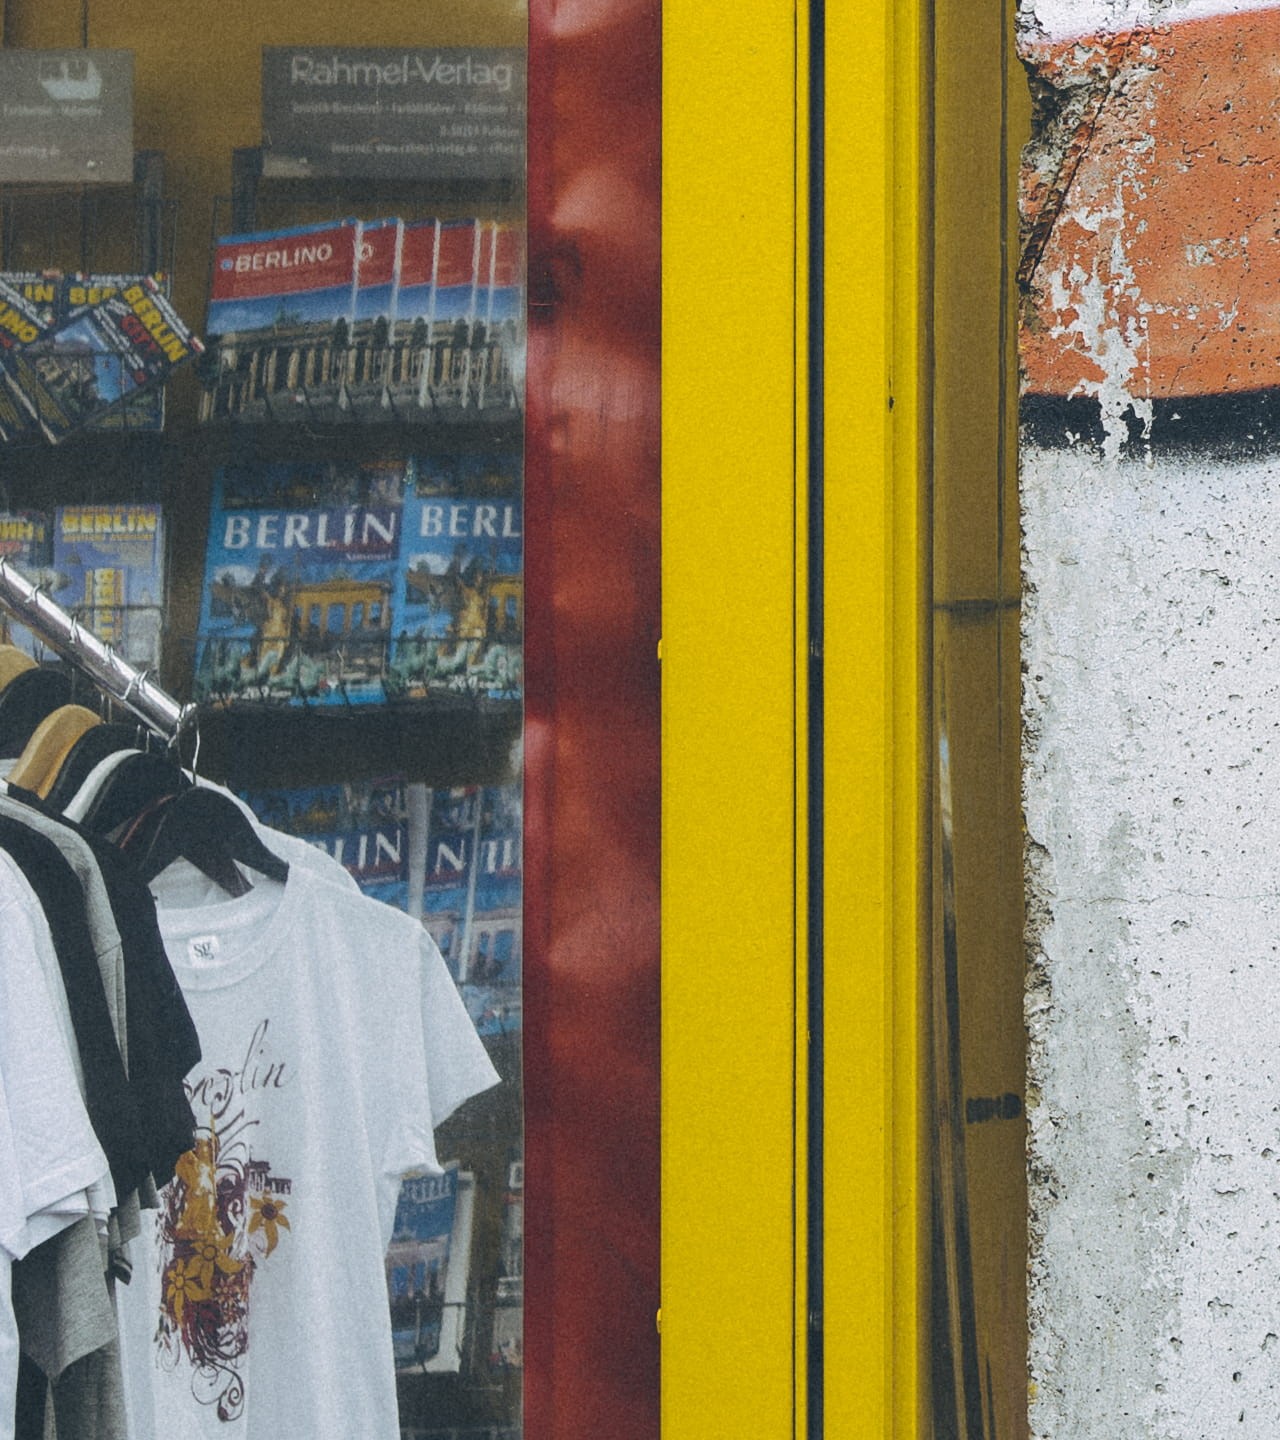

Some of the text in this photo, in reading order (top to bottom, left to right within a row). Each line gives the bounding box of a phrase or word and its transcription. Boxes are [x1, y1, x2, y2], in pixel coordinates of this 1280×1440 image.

[290, 54, 513, 93] Rahmel-Verlag
[235, 243, 333, 273] BERLINO
[122, 284, 189, 362] BERLIN
[419, 504, 522, 538] BERL
[181, 1018, 286, 1119] erlin
